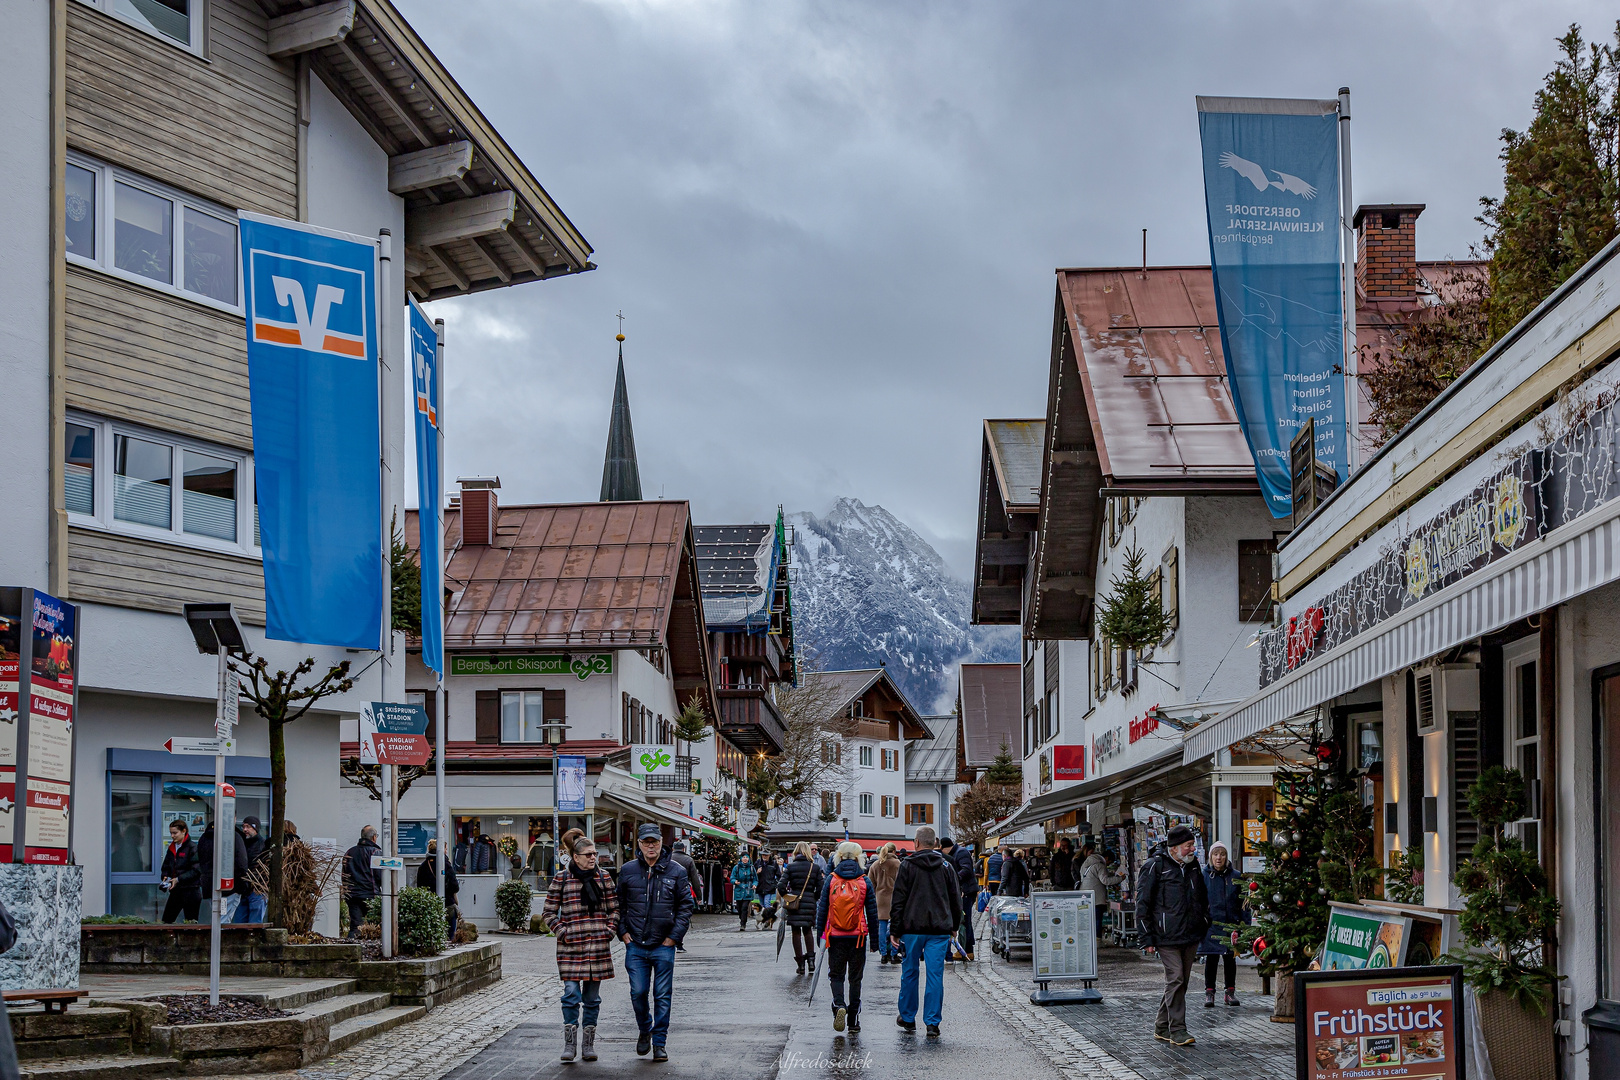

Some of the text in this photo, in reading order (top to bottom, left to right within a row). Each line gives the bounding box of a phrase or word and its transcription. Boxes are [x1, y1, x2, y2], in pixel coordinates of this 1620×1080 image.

[456, 656, 562, 672] Bergsport Skisport
[385, 706, 418, 714] SKISPRUNG-
[1336, 926, 1365, 948] UNSER BIER
[1371, 990, 1407, 1004] Täglich
[1313, 1003, 1444, 1036] Frühstück
[1342, 1069, 1375, 1078] Frühstück
[1391, 1067, 1408, 1075] carte
